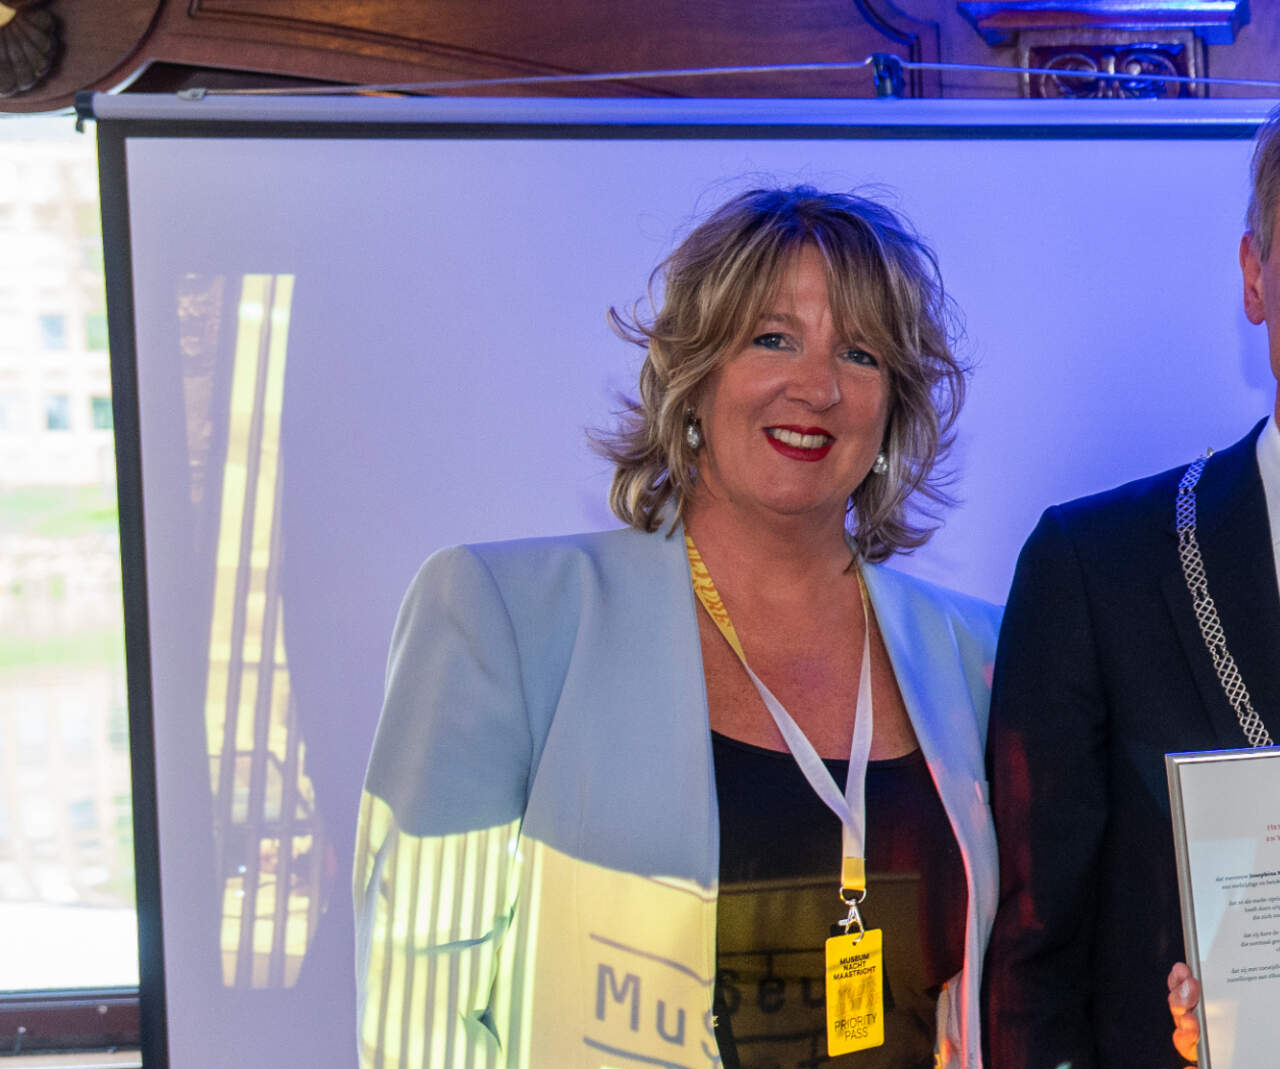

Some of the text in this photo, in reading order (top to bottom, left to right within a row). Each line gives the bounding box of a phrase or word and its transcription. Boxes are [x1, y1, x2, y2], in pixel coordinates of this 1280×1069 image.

[840, 953, 870, 965] MUSEUM
[843, 961, 866, 971] NACHT
[833, 966, 876, 980] MAASTRICHT
[834, 1013, 876, 1032] PRIORITY
[844, 1026, 869, 1040] PASS
